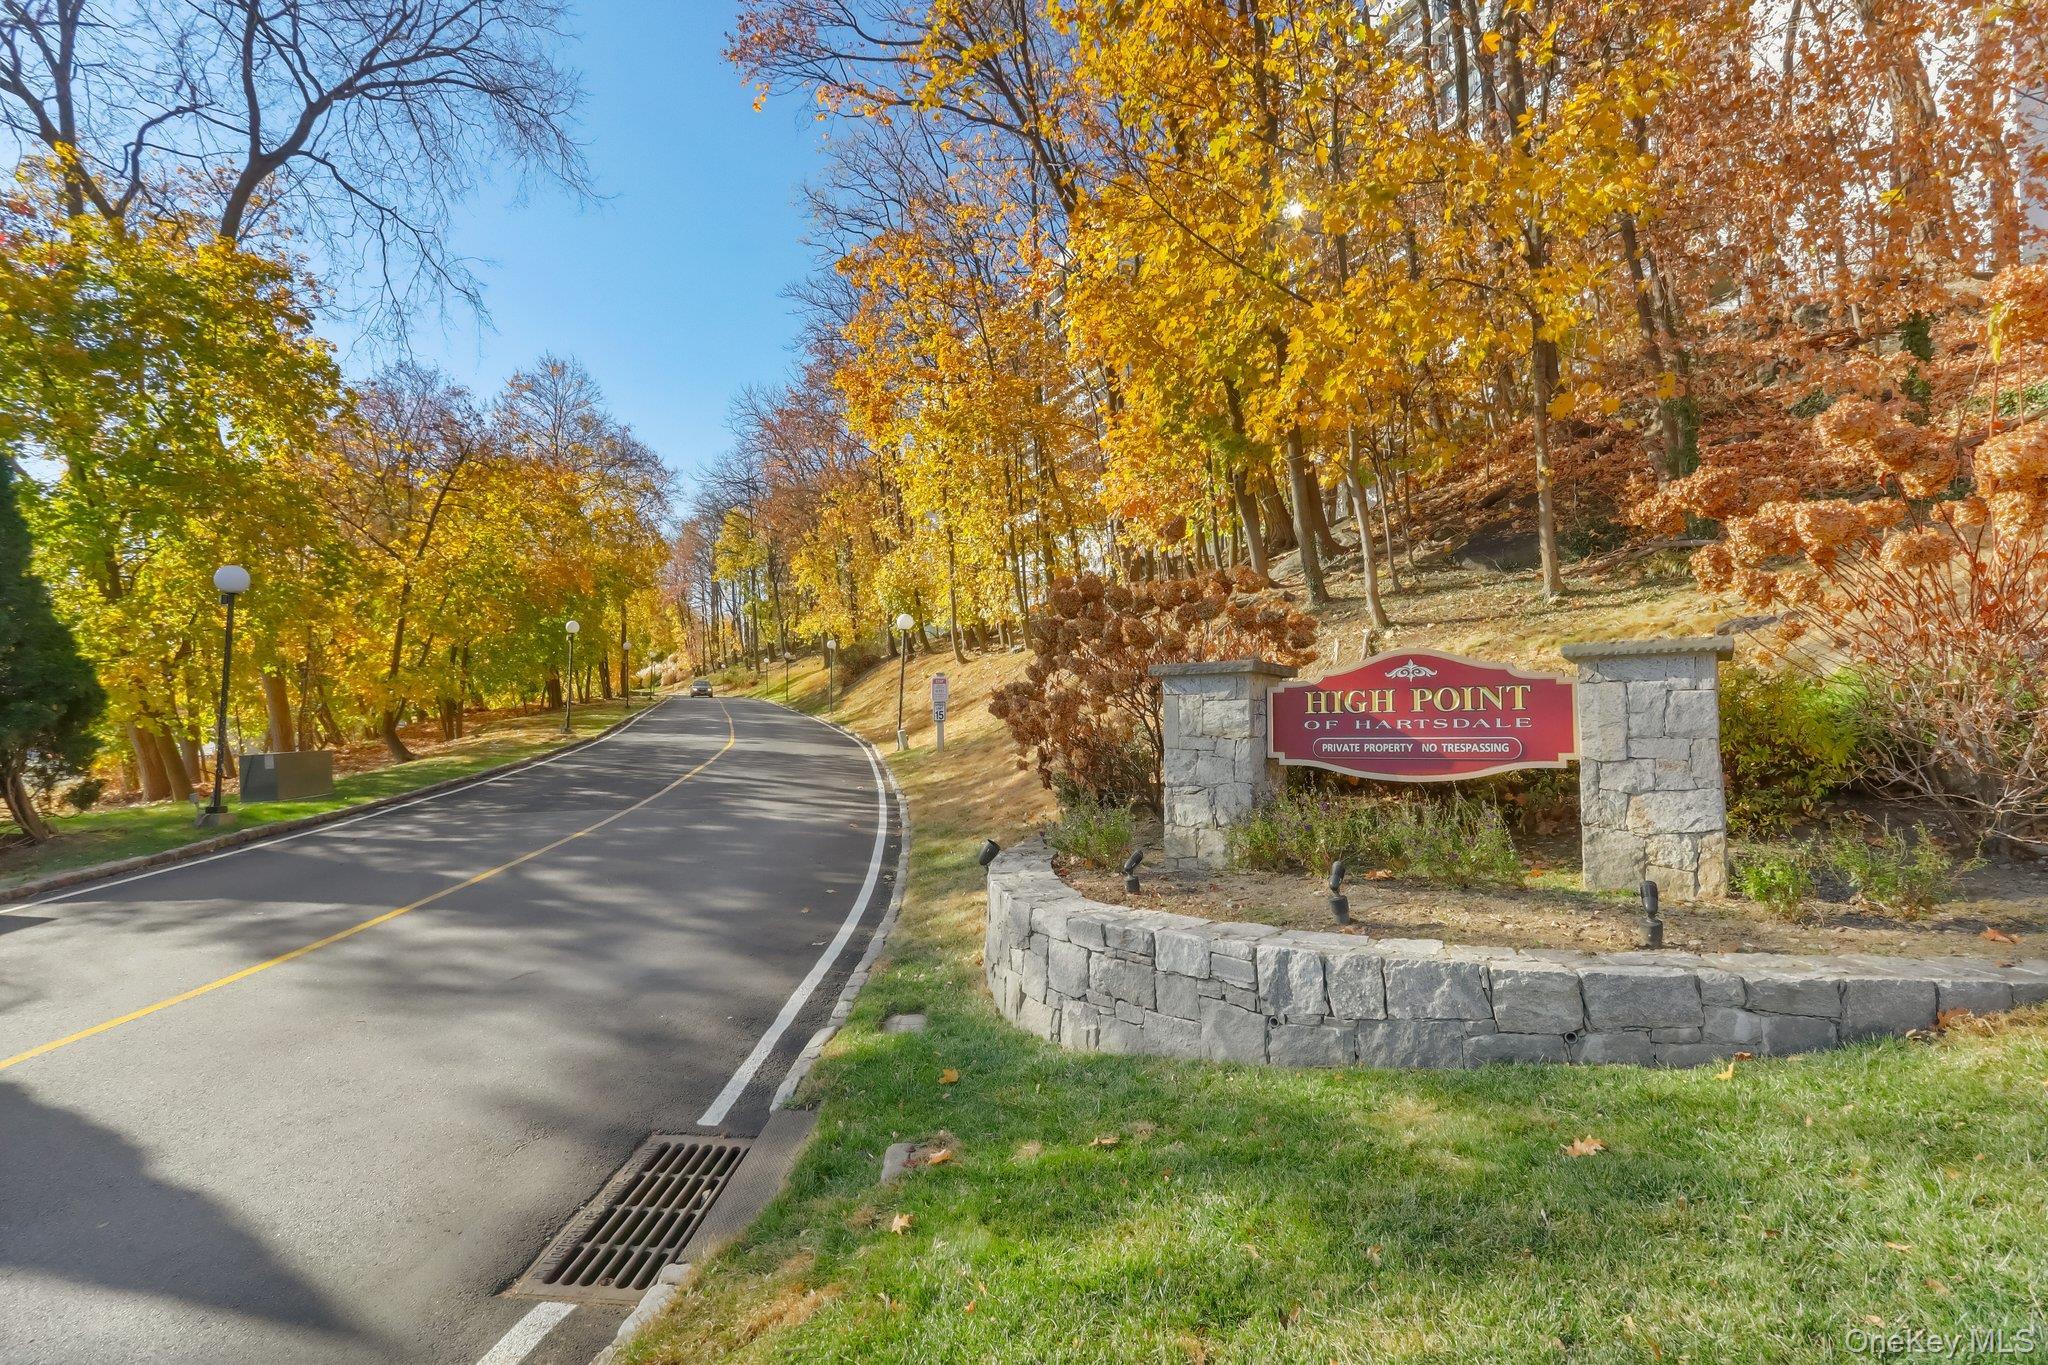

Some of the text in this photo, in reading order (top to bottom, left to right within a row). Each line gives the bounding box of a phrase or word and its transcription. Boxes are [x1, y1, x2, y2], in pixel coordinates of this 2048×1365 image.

[1305, 685, 1531, 714] HIGH POINT
[935, 710, 944, 720] 15
[1304, 717, 1533, 730] OF HARTSDALE
[1322, 742, 1510, 753] PRIVATE PROPERTY NO TRESPASSING
